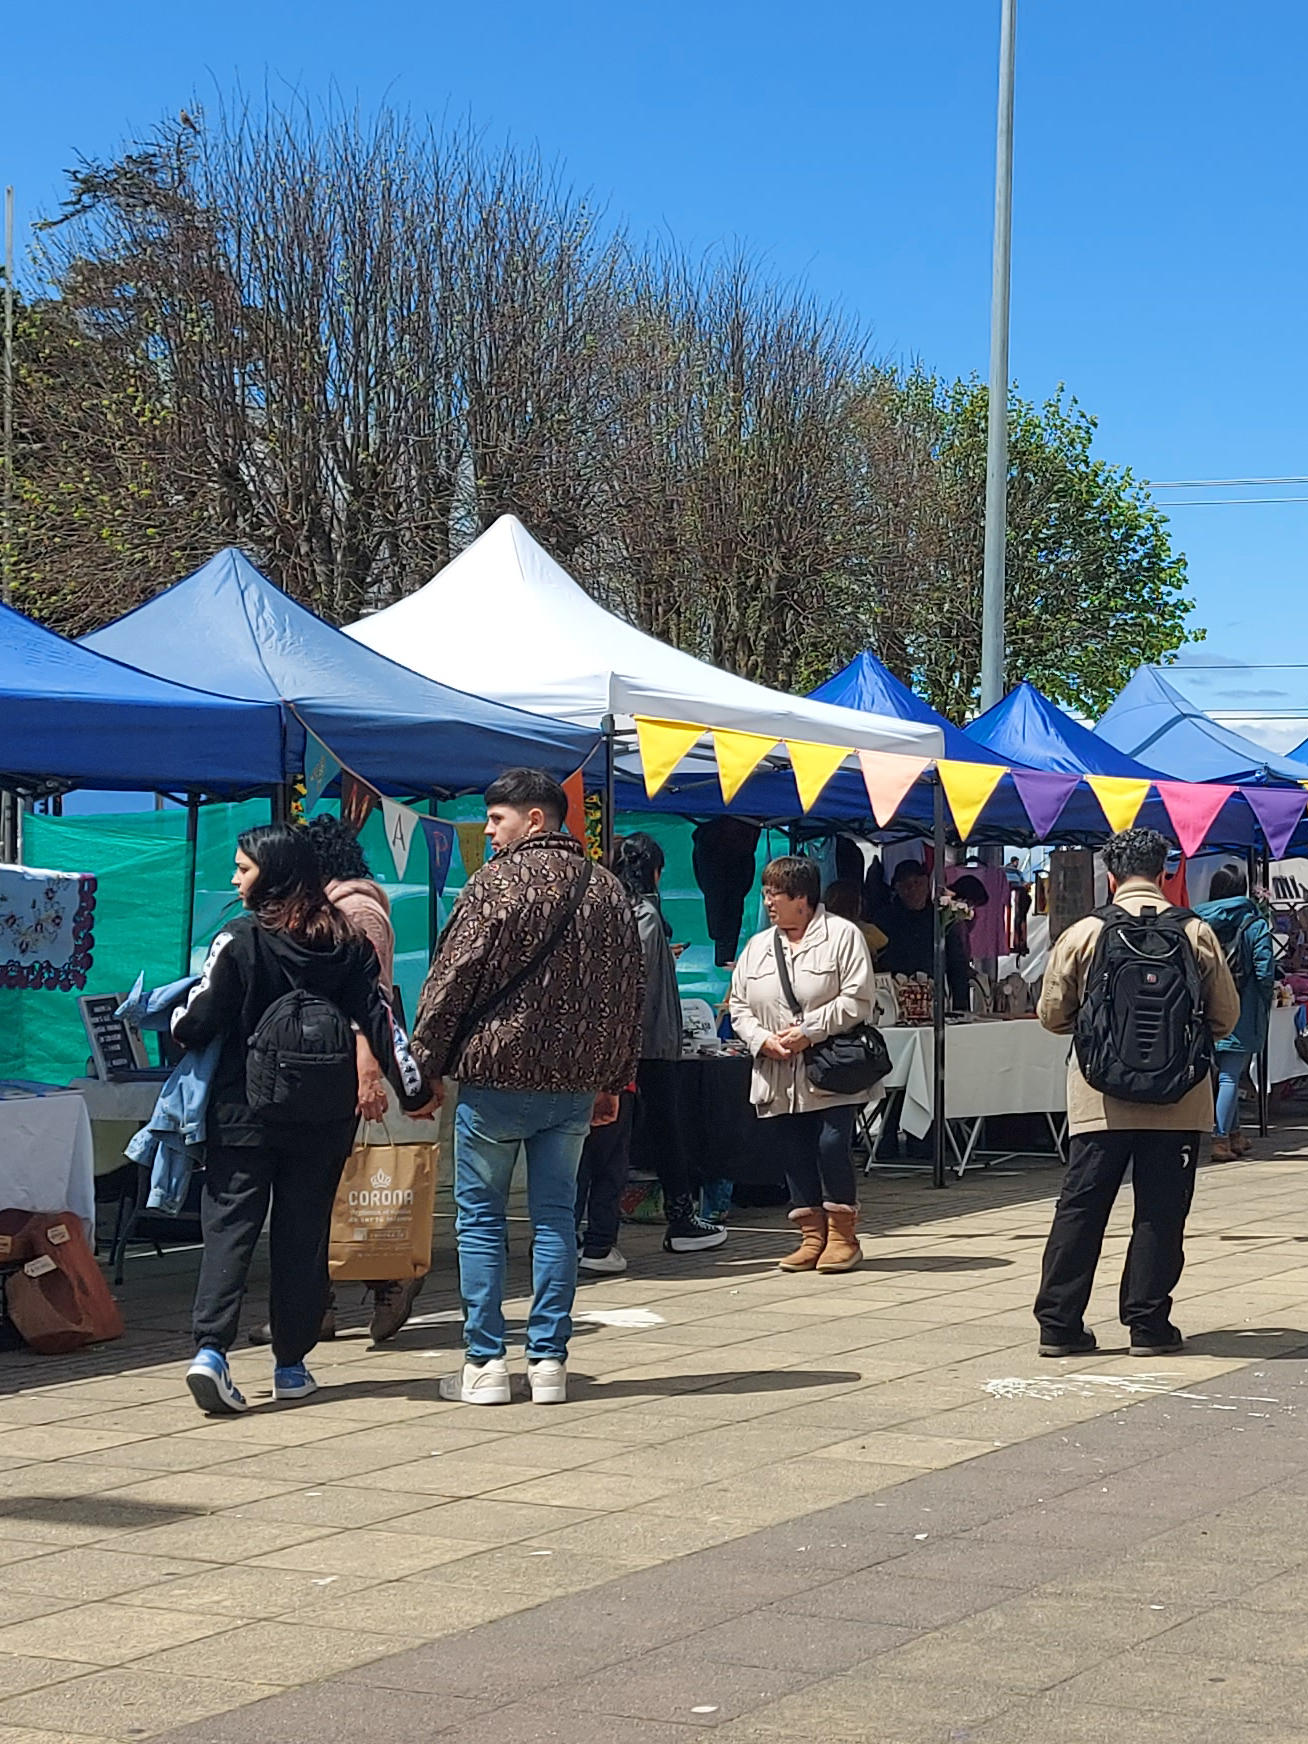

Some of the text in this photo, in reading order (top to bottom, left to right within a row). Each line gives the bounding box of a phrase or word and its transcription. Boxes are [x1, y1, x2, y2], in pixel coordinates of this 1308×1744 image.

[391, 813, 406, 852] A
[433, 830, 448, 867] P
[348, 1189, 414, 1206] CORONA
